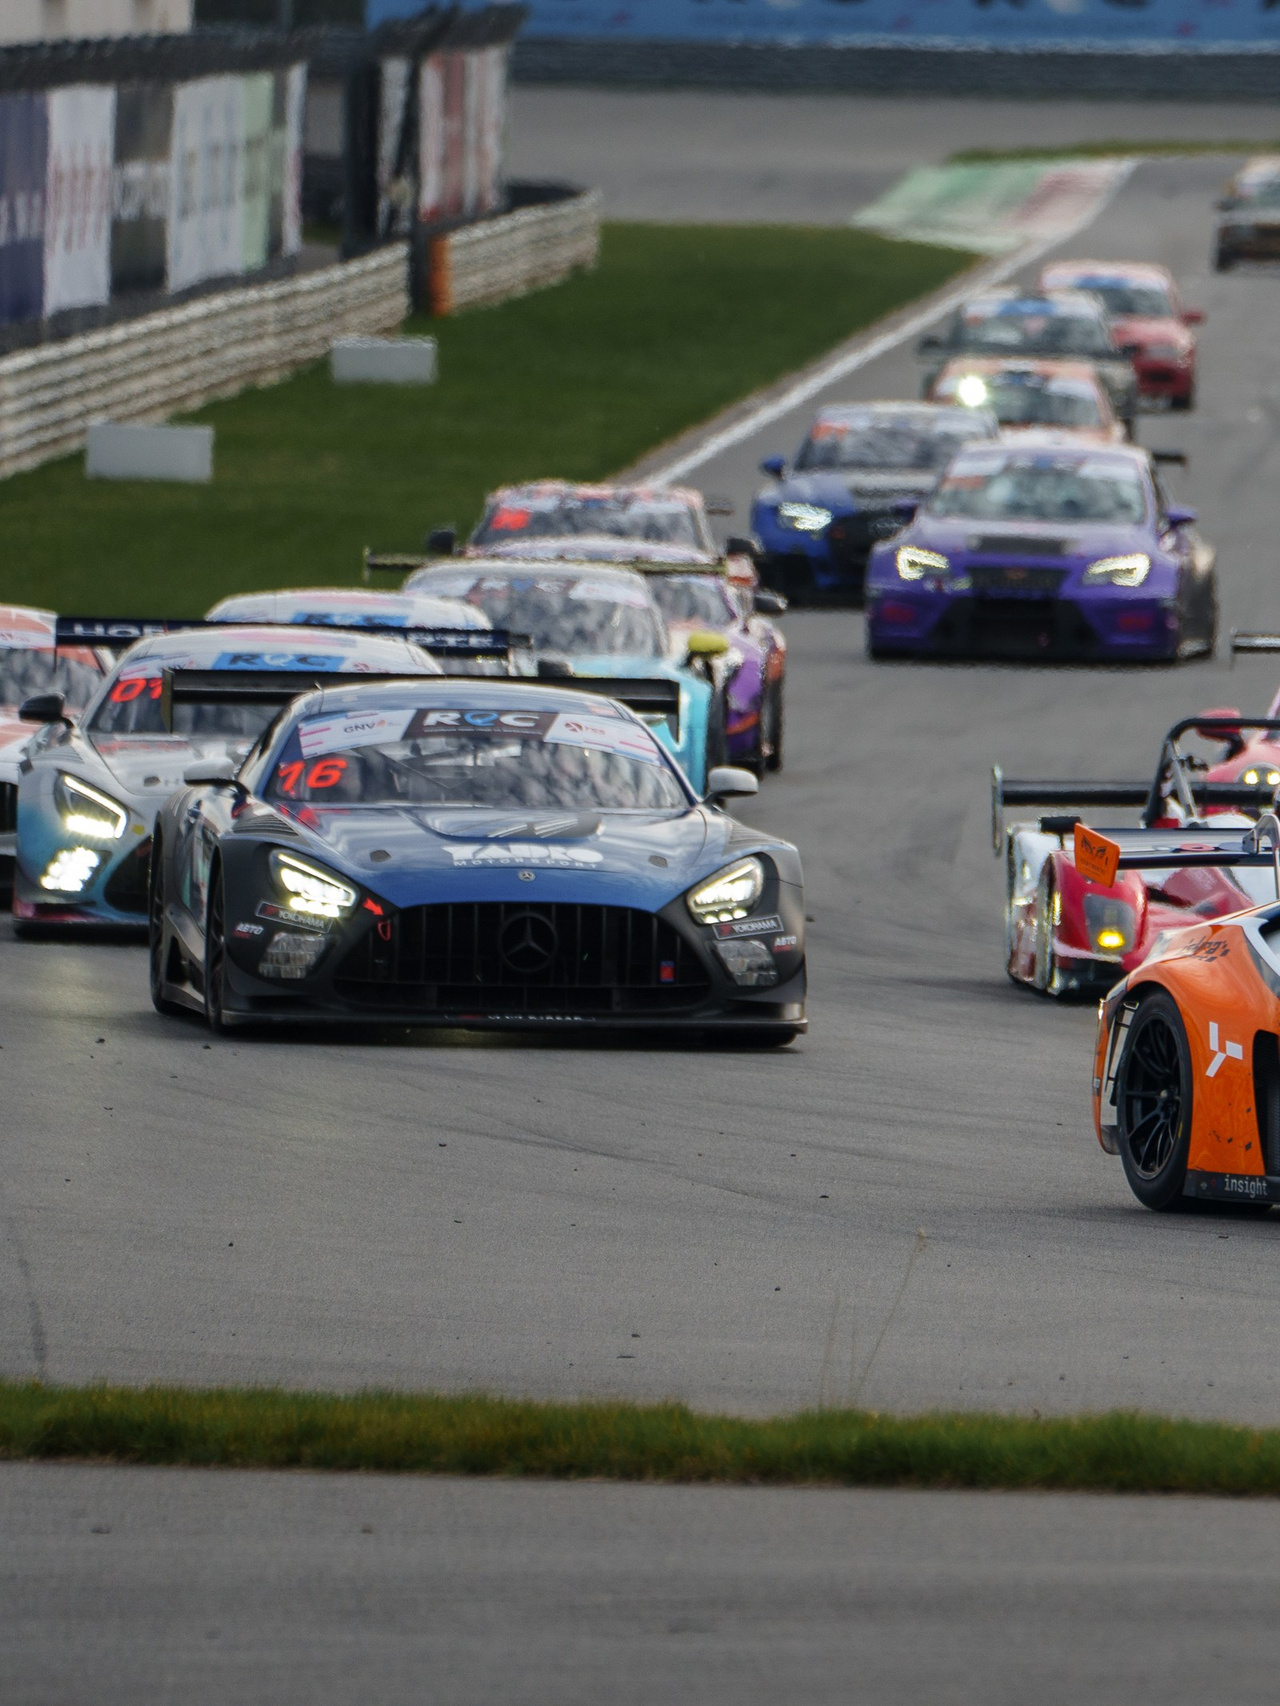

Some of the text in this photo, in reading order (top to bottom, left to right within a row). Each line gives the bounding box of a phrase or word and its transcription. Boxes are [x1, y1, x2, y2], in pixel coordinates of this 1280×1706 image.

[278, 757, 348, 793] 16
[453, 857, 598, 869] MOTORSPORT
[278, 909, 325, 929] YOKOHAMA
[732, 919, 778, 934] YOKOHAMA
[1223, 1174, 1269, 1199] insight
